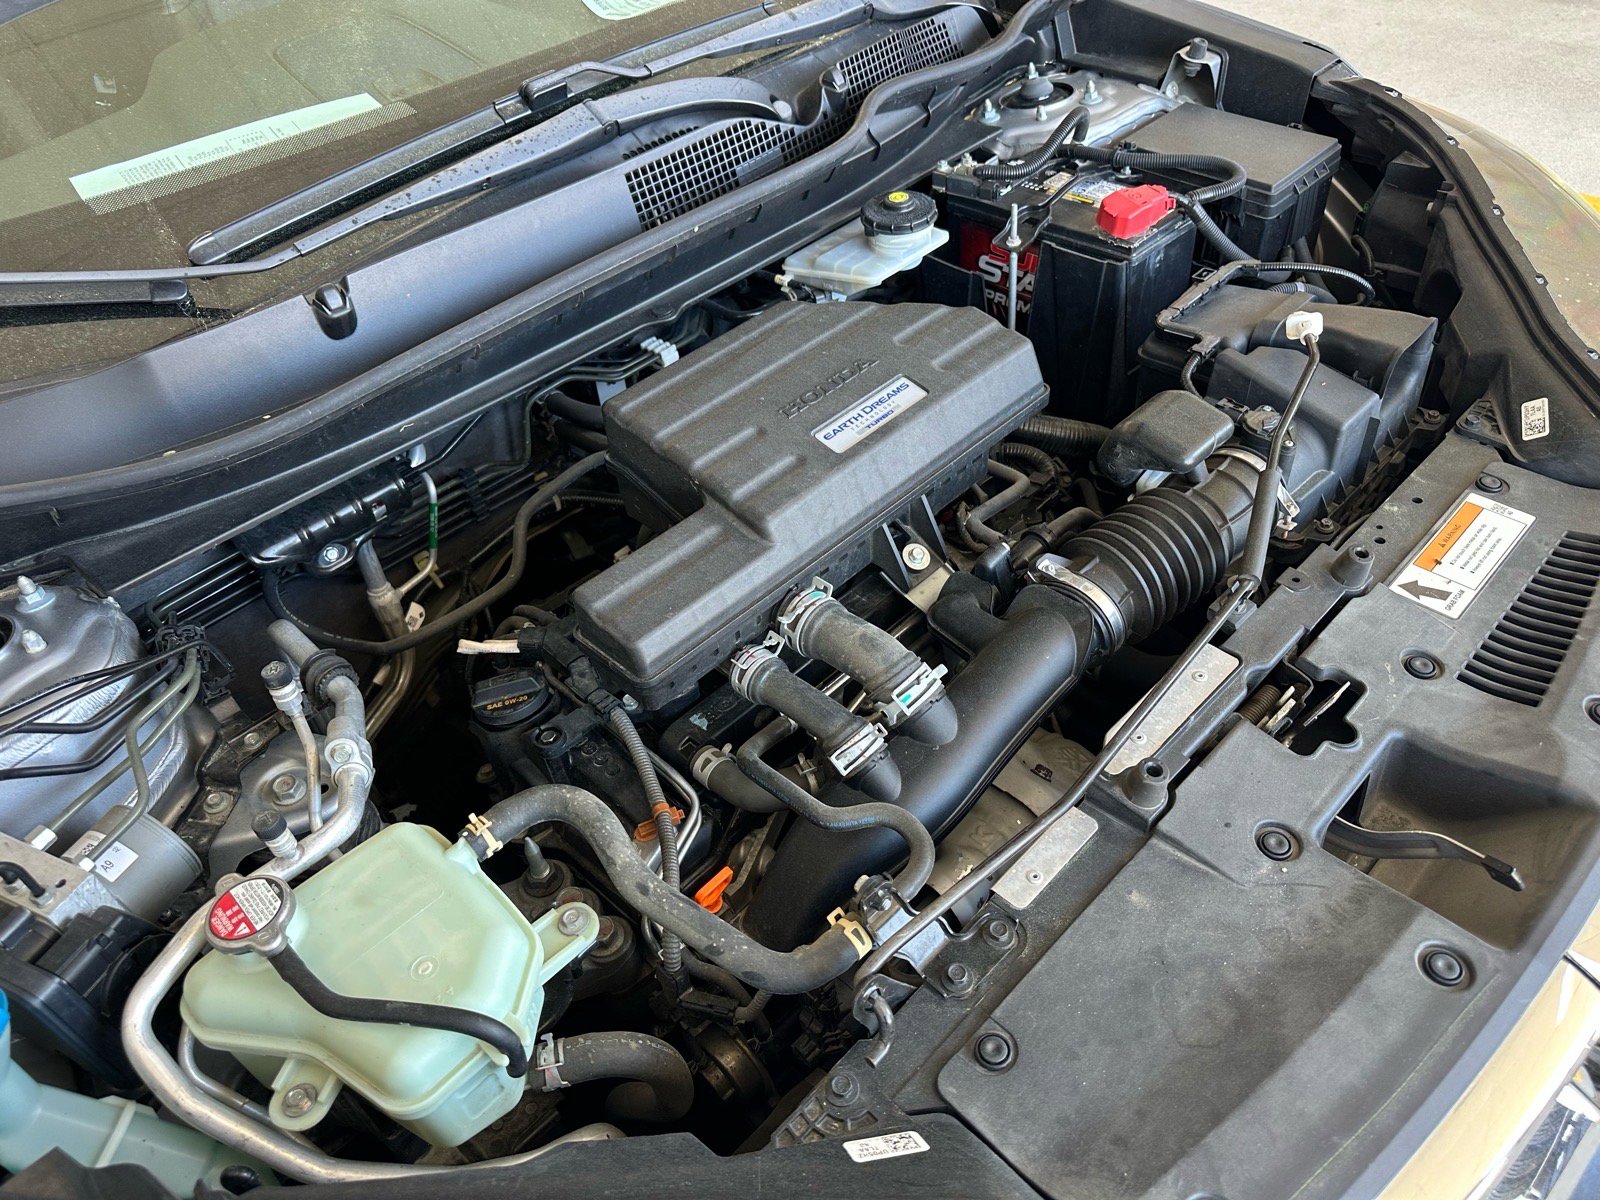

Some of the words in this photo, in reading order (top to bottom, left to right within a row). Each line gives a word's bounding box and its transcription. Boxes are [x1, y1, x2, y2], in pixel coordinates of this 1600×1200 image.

[778, 358, 880, 420] HONDA
[823, 413, 864, 441] EARTH
[861, 382, 910, 415] DREAMS
[865, 409, 895, 430] TURBO
[486, 701, 503, 711] SAE
[504, 695, 528, 706] 0W-20
[100, 860, 114, 872] A9
[211, 916, 228, 936] DANGER
[215, 907, 234, 932] WARNING
